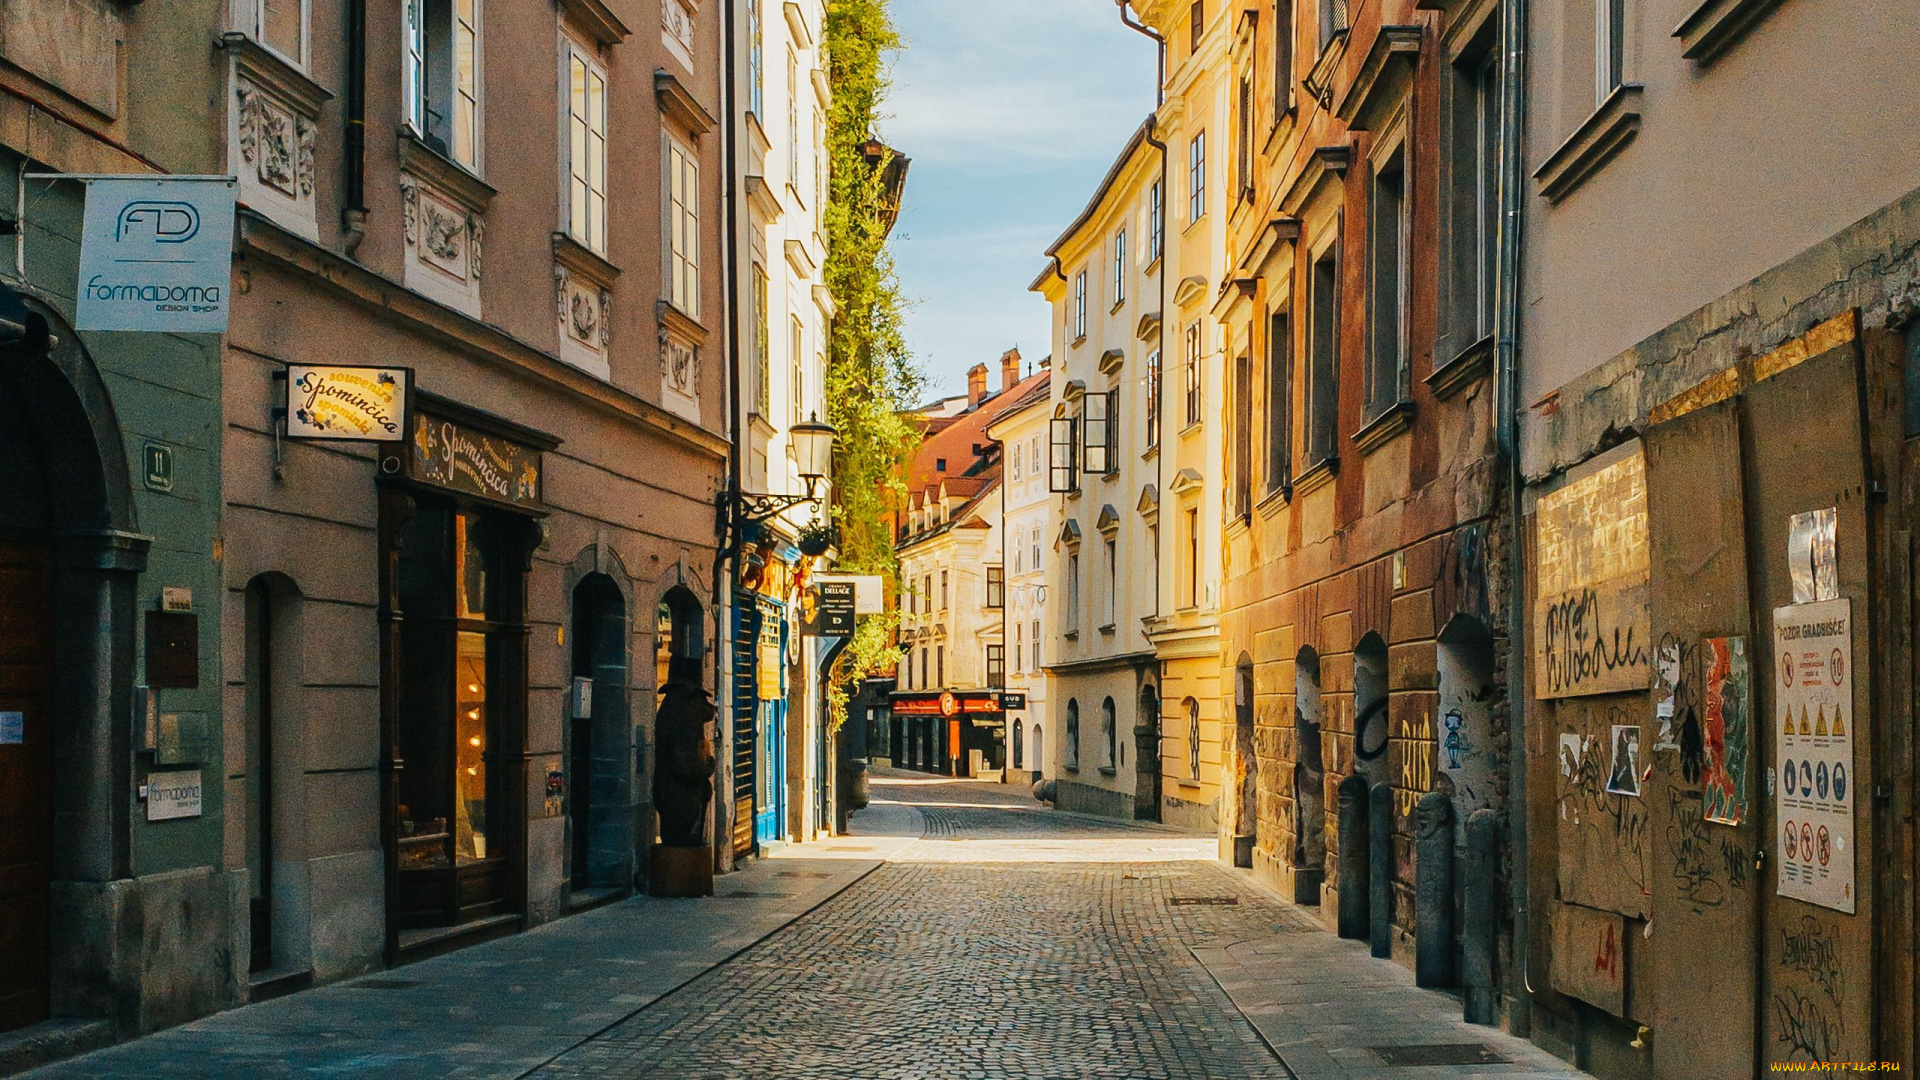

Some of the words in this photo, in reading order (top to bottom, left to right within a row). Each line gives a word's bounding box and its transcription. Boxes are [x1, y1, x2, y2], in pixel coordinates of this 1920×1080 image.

[156, 304, 189, 312] DESIGN
[192, 304, 220, 312] SHOP
[301, 371, 399, 434] Spominčica
[328, 371, 393, 404] souvenirs
[316, 399, 374, 436] spominki
[441, 421, 509, 497] Spominčica
[1779, 624, 1801, 642] POZOR
